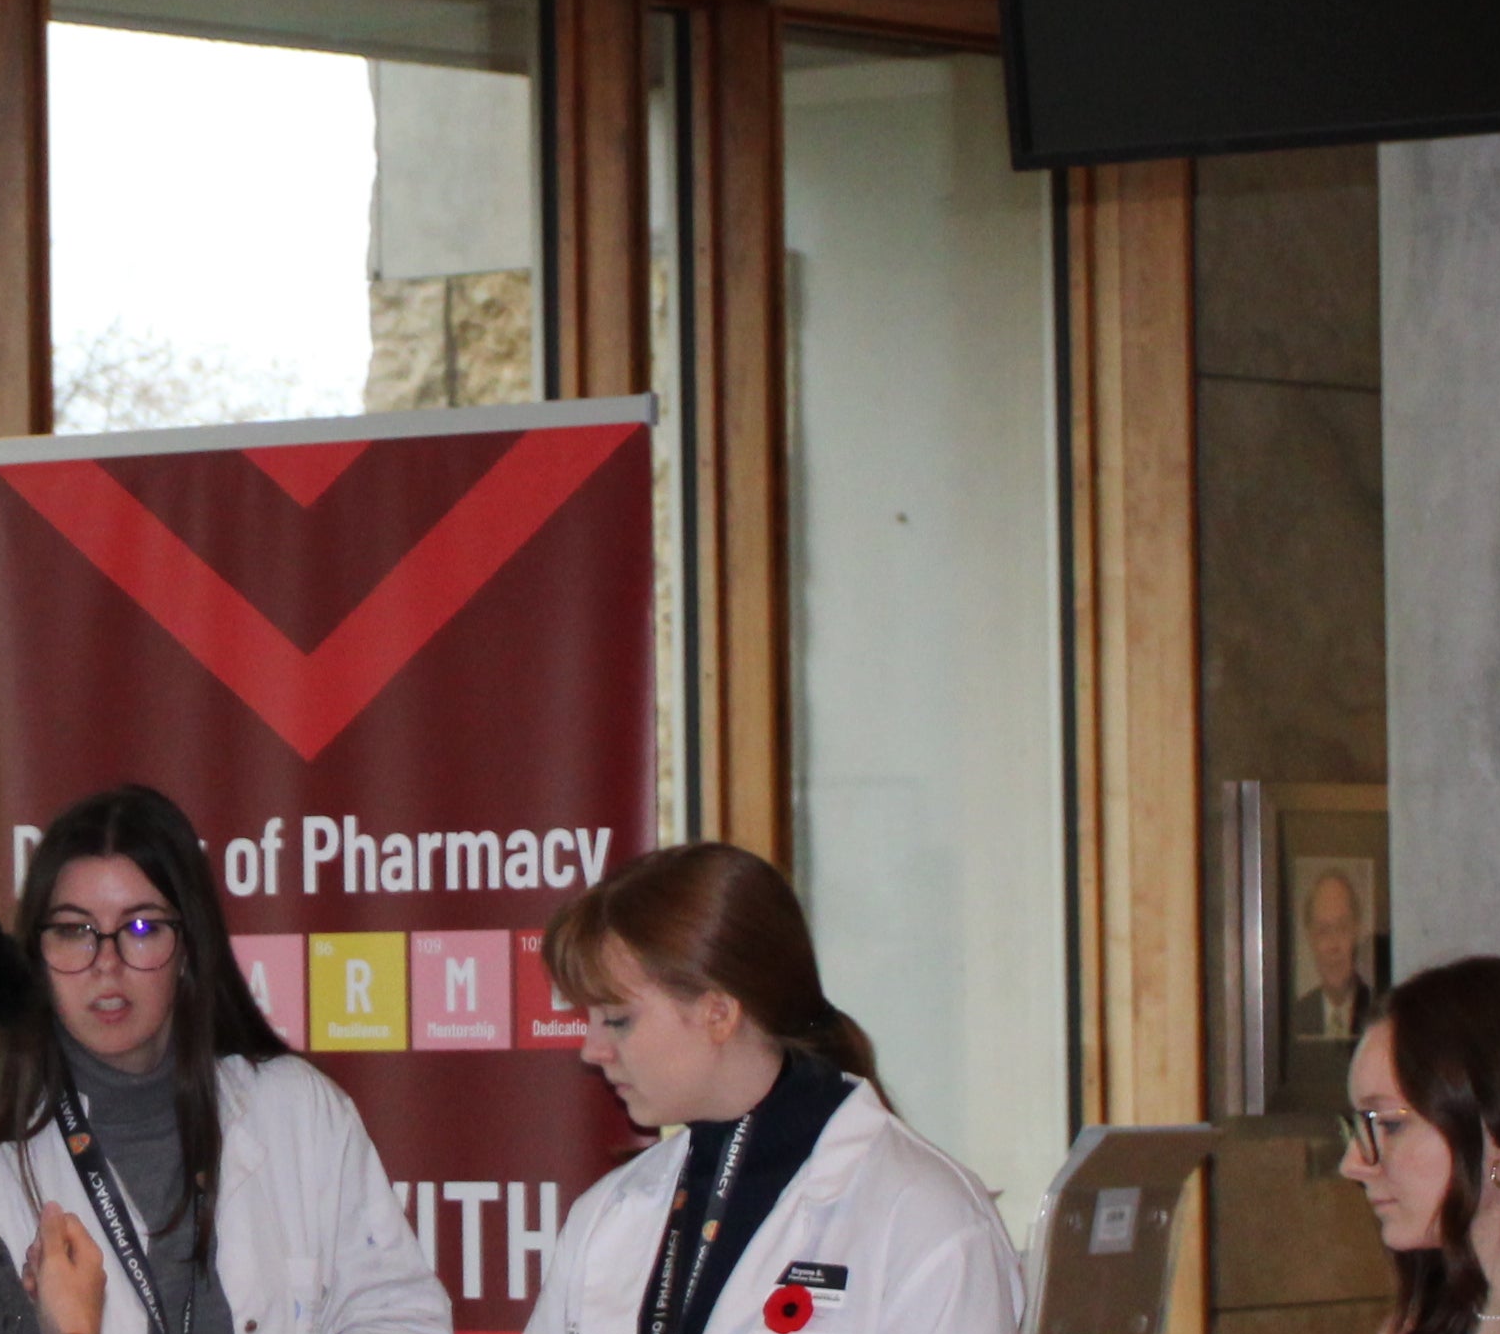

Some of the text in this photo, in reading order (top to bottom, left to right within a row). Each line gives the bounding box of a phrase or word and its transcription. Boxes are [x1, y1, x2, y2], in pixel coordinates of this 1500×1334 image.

[224, 815, 612, 898] of Pharmacy
[345, 958, 374, 1014] R
[445, 957, 476, 1012] M
[427, 1021, 496, 1041] Mentorship
[532, 1019, 588, 1036] Dedicatio
[88, 1170, 129, 1248] PHARMACY
